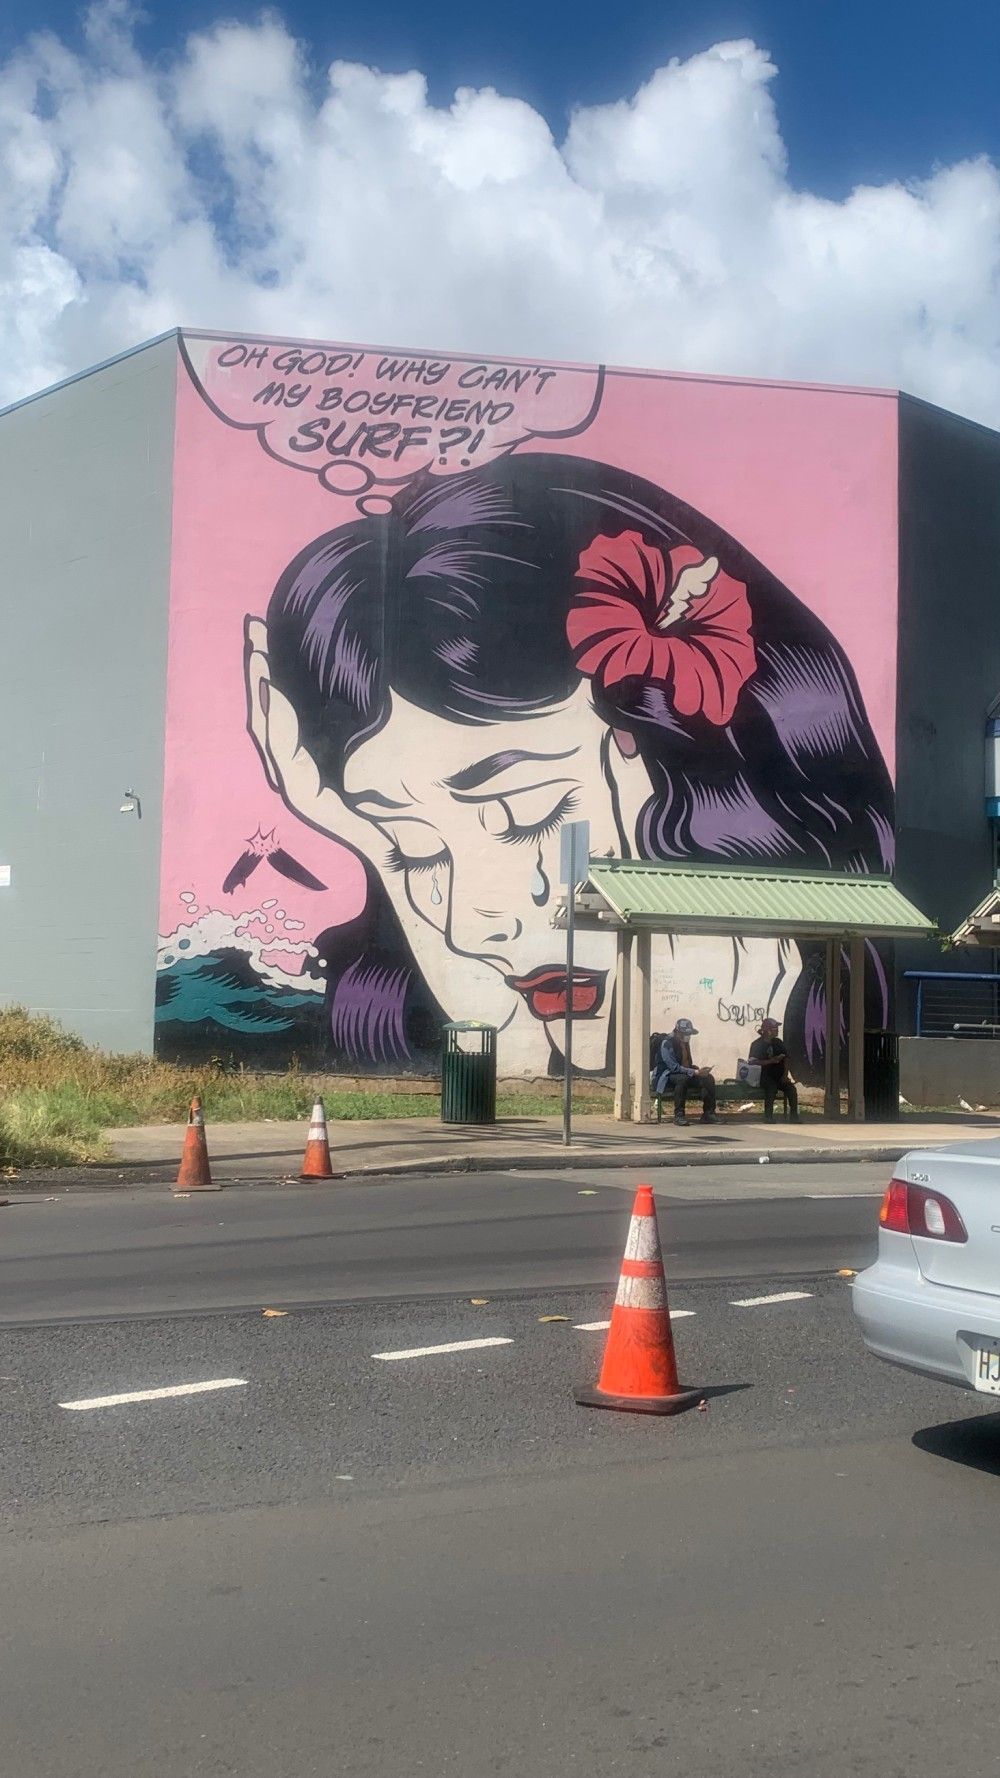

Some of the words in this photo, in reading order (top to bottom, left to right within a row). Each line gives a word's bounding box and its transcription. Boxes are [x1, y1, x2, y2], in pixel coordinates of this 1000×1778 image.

[217, 344, 269, 369] OH
[273, 349, 363, 377] GOD!
[375, 357, 451, 386] WHY
[458, 366, 556, 395] CAN'T
[253, 381, 312, 408] MY
[315, 387, 515, 426] BOYFRIEND
